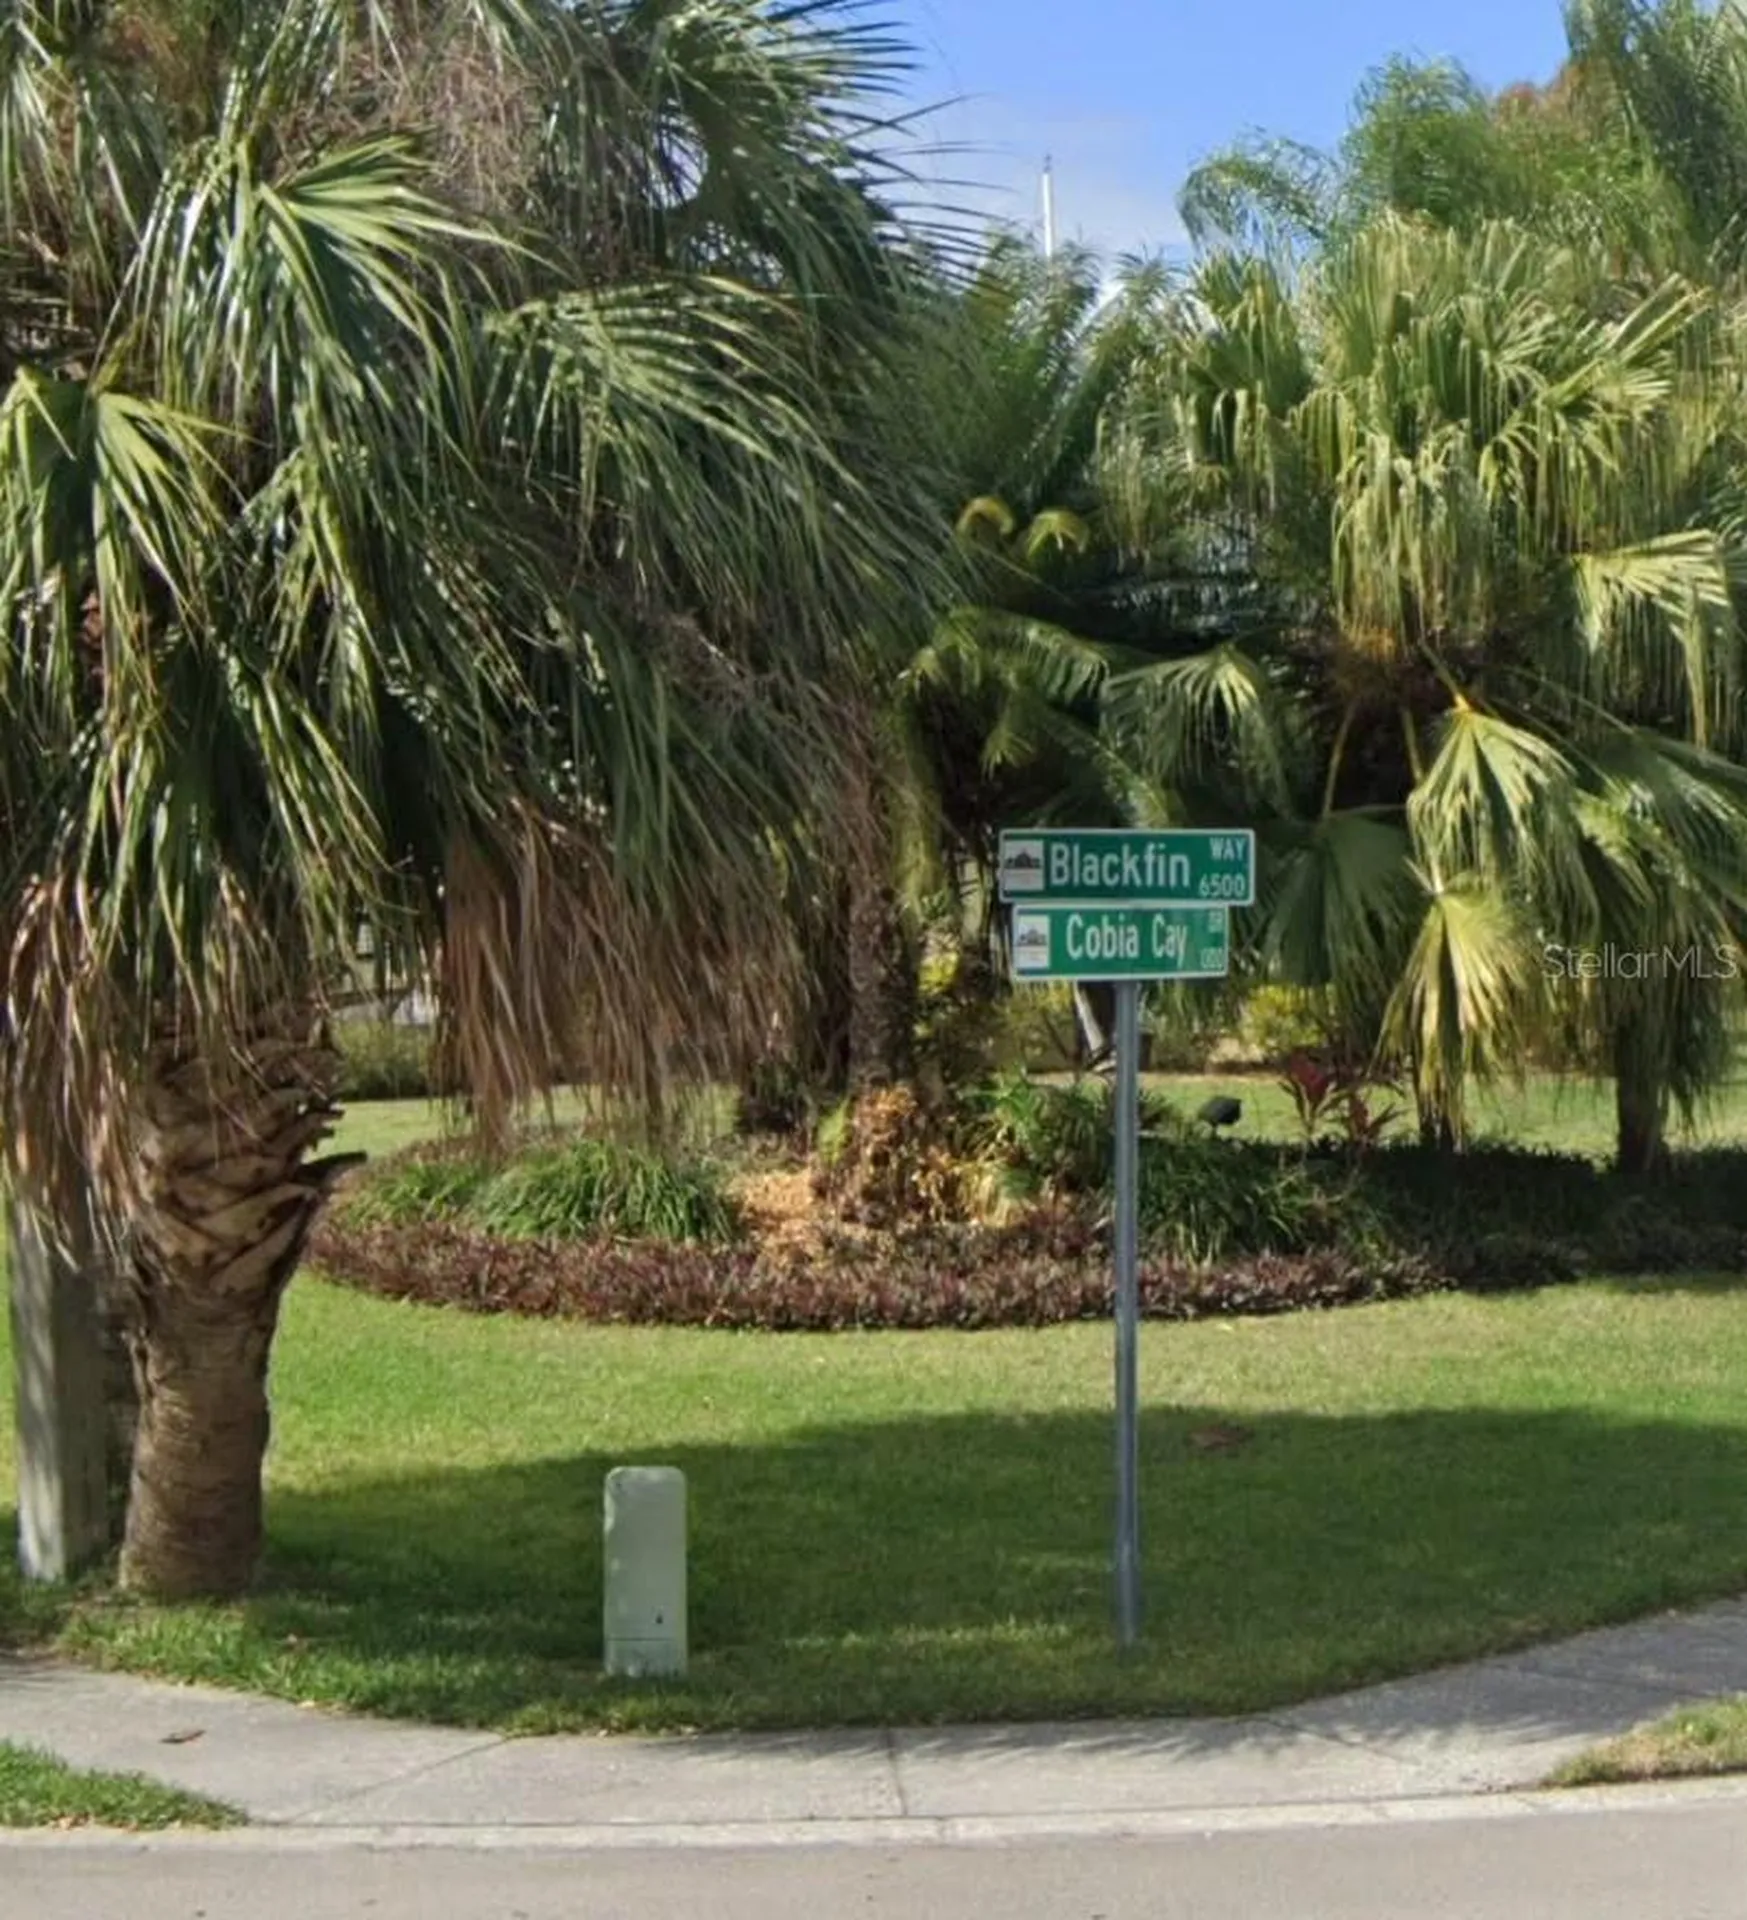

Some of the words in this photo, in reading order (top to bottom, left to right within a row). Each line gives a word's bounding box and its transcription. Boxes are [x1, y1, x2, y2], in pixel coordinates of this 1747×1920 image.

[1050, 843, 1190, 888] Blackfin
[1209, 837, 1246, 861] WAY
[1199, 874, 1246, 897] 6500
[1066, 913, 1139, 960] Cobia
[1152, 912, 1188, 968] Cay
